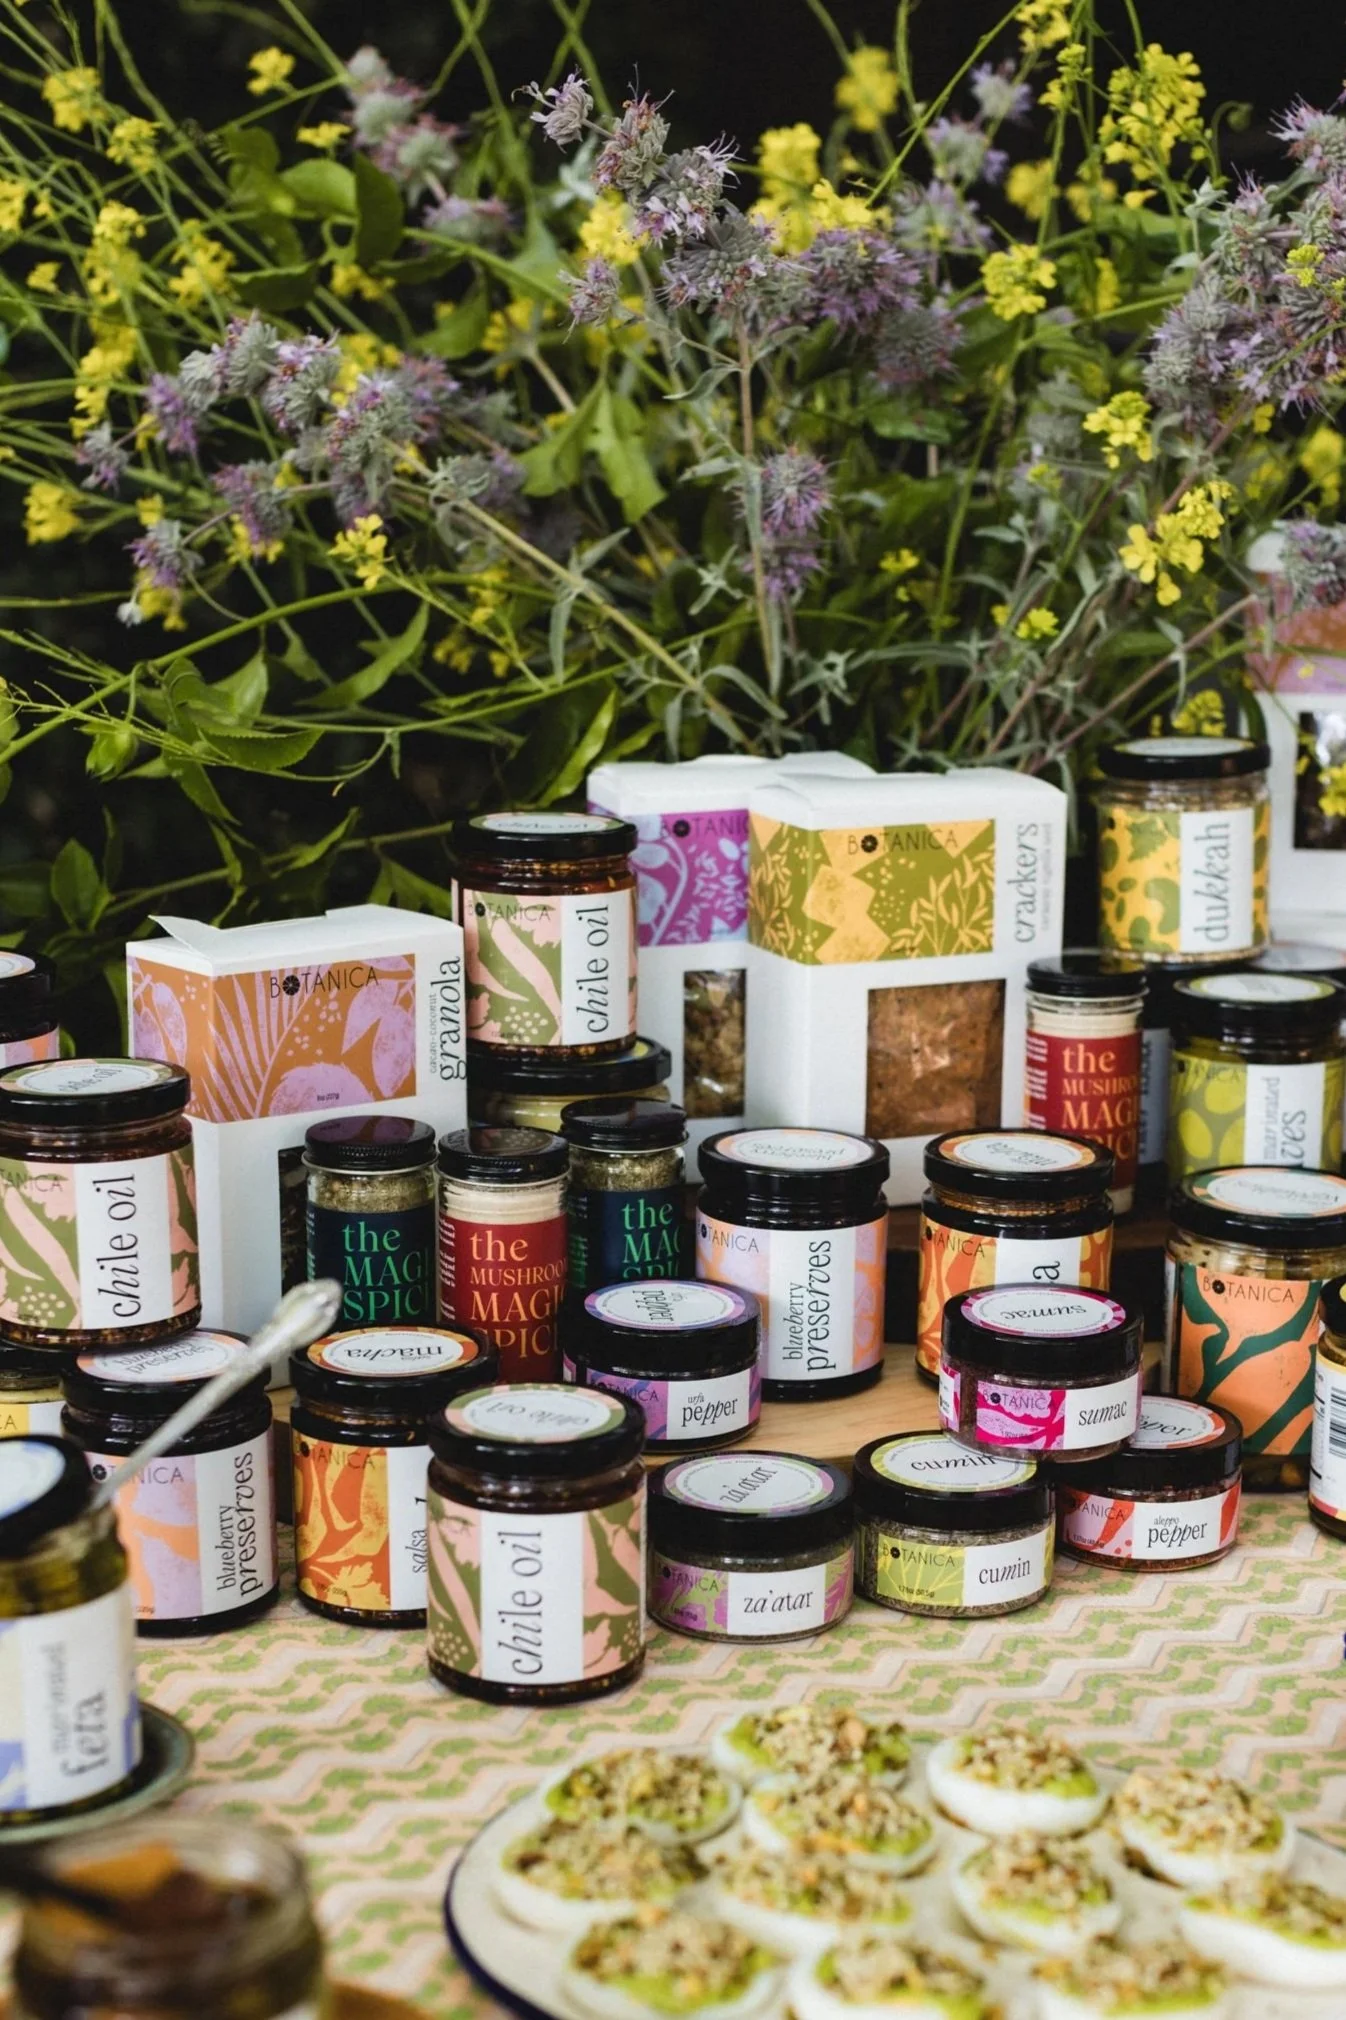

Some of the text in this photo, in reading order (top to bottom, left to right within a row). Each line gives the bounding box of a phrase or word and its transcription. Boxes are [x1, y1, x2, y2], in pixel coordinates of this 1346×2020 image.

[661, 815, 748, 838] OTANI
[848, 829, 958, 855] BOTANICA
[1007, 823, 1038, 943] crackers
[1194, 820, 1231, 942] dukkah
[270, 966, 379, 998] BOTANICA
[576, 904, 609, 1033] chile oil
[429, 993, 437, 1074] cacao-coconut
[430, 955, 467, 1081] granola
[1062, 1042, 1116, 1073] the
[621, 1198, 673, 1230] the
[92, 1174, 141, 1318] chile oil
[342, 1221, 401, 1252] the
[470, 1230, 528, 1261] the
[923, 1225, 985, 1258] OTANICA
[1203, 1275, 1295, 1303] BOTANICA
[632, 1290, 674, 1321] pepper
[807, 1239, 836, 1373] preserves
[1000, 1304, 1087, 1320] sumac
[782, 1282, 804, 1361] blueberry
[344, 1345, 442, 1361] macha
[594, 1381, 659, 1402] OTANICA
[688, 1392, 704, 1405] urfa
[682, 1398, 738, 1428] pepper
[1078, 1401, 1127, 1427] sumac
[234, 1452, 263, 1597] preserves
[1147, 1522, 1208, 1548] pepper
[1154, 1515, 1180, 1527] aleppo
[215, 1505, 238, 1591] blueberry
[405, 1528, 428, 1573] salsa
[882, 1543, 956, 1567] BOTANICA
[662, 1566, 720, 1593] OTANICA
[978, 1557, 1031, 1585] cumin
[497, 1530, 543, 1675] chile oil
[60, 1688, 110, 1777] feta
